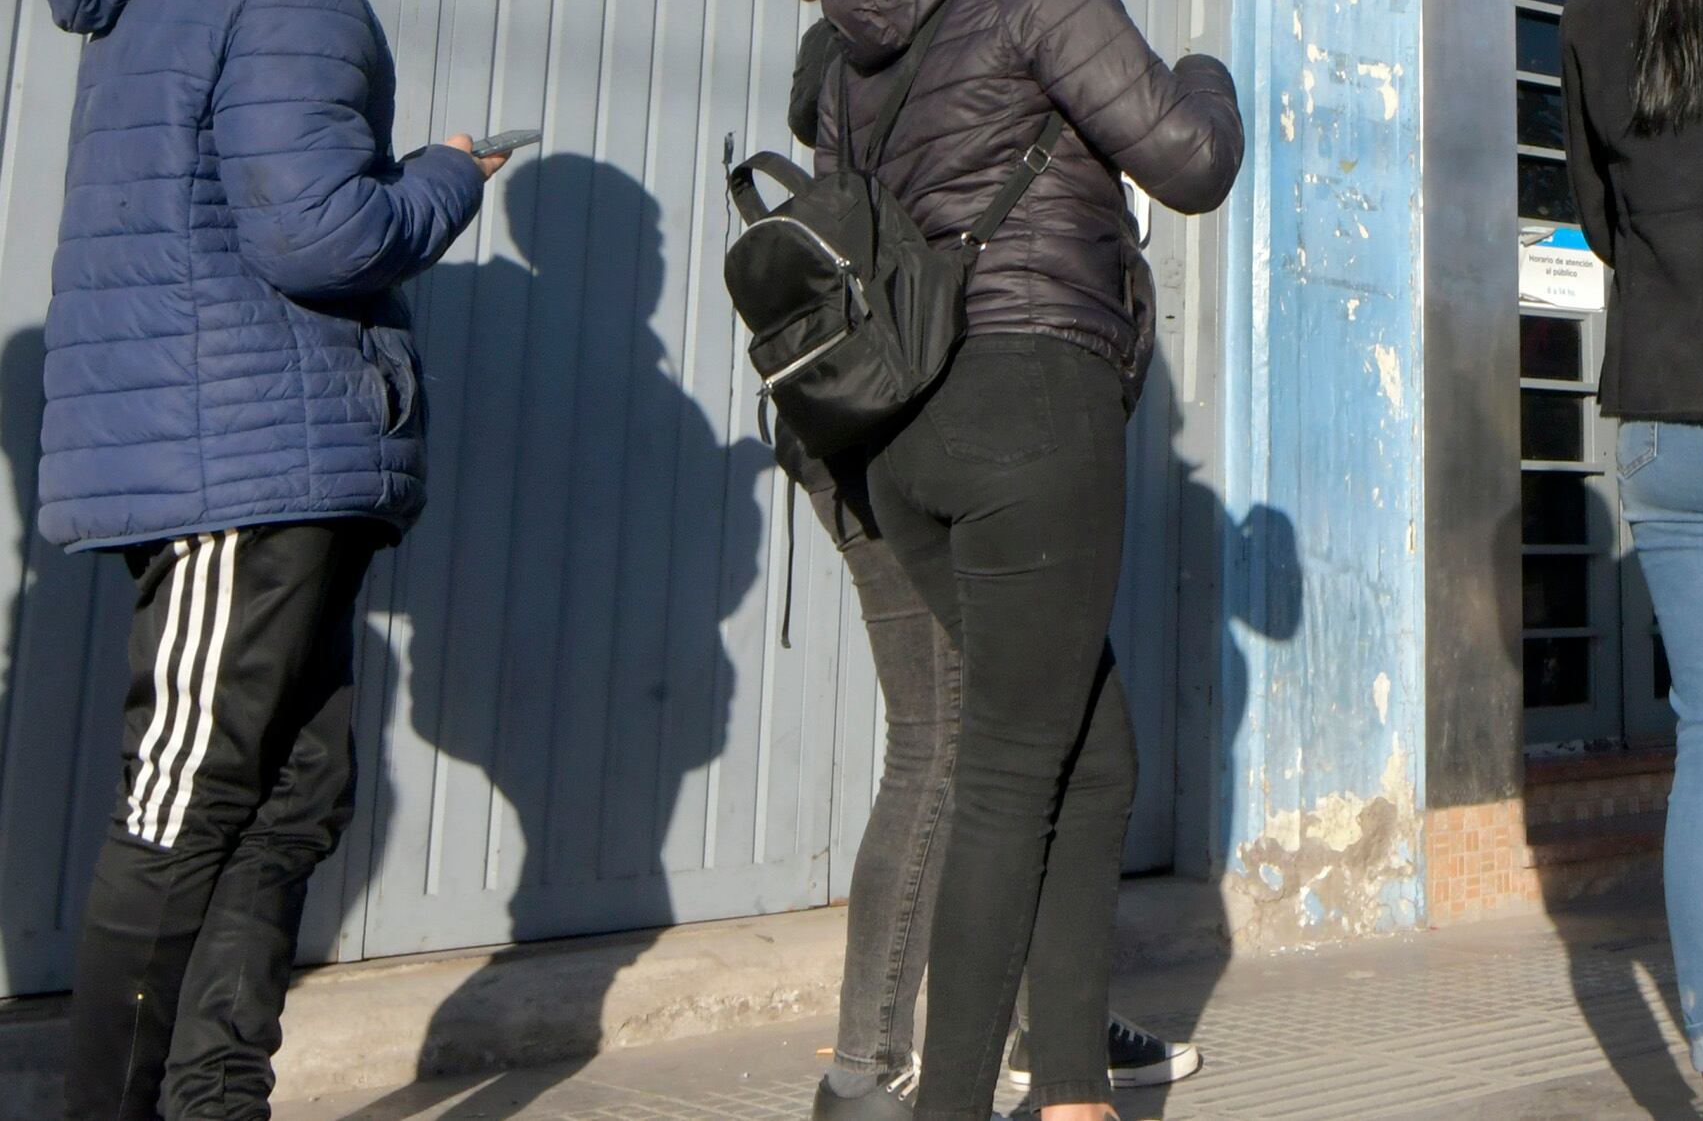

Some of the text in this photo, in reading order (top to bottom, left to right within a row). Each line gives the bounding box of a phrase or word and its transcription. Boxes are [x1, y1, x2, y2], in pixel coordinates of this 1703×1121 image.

[1529, 254, 1593, 268] Horario de atención
[1546, 267, 1577, 278] al público
